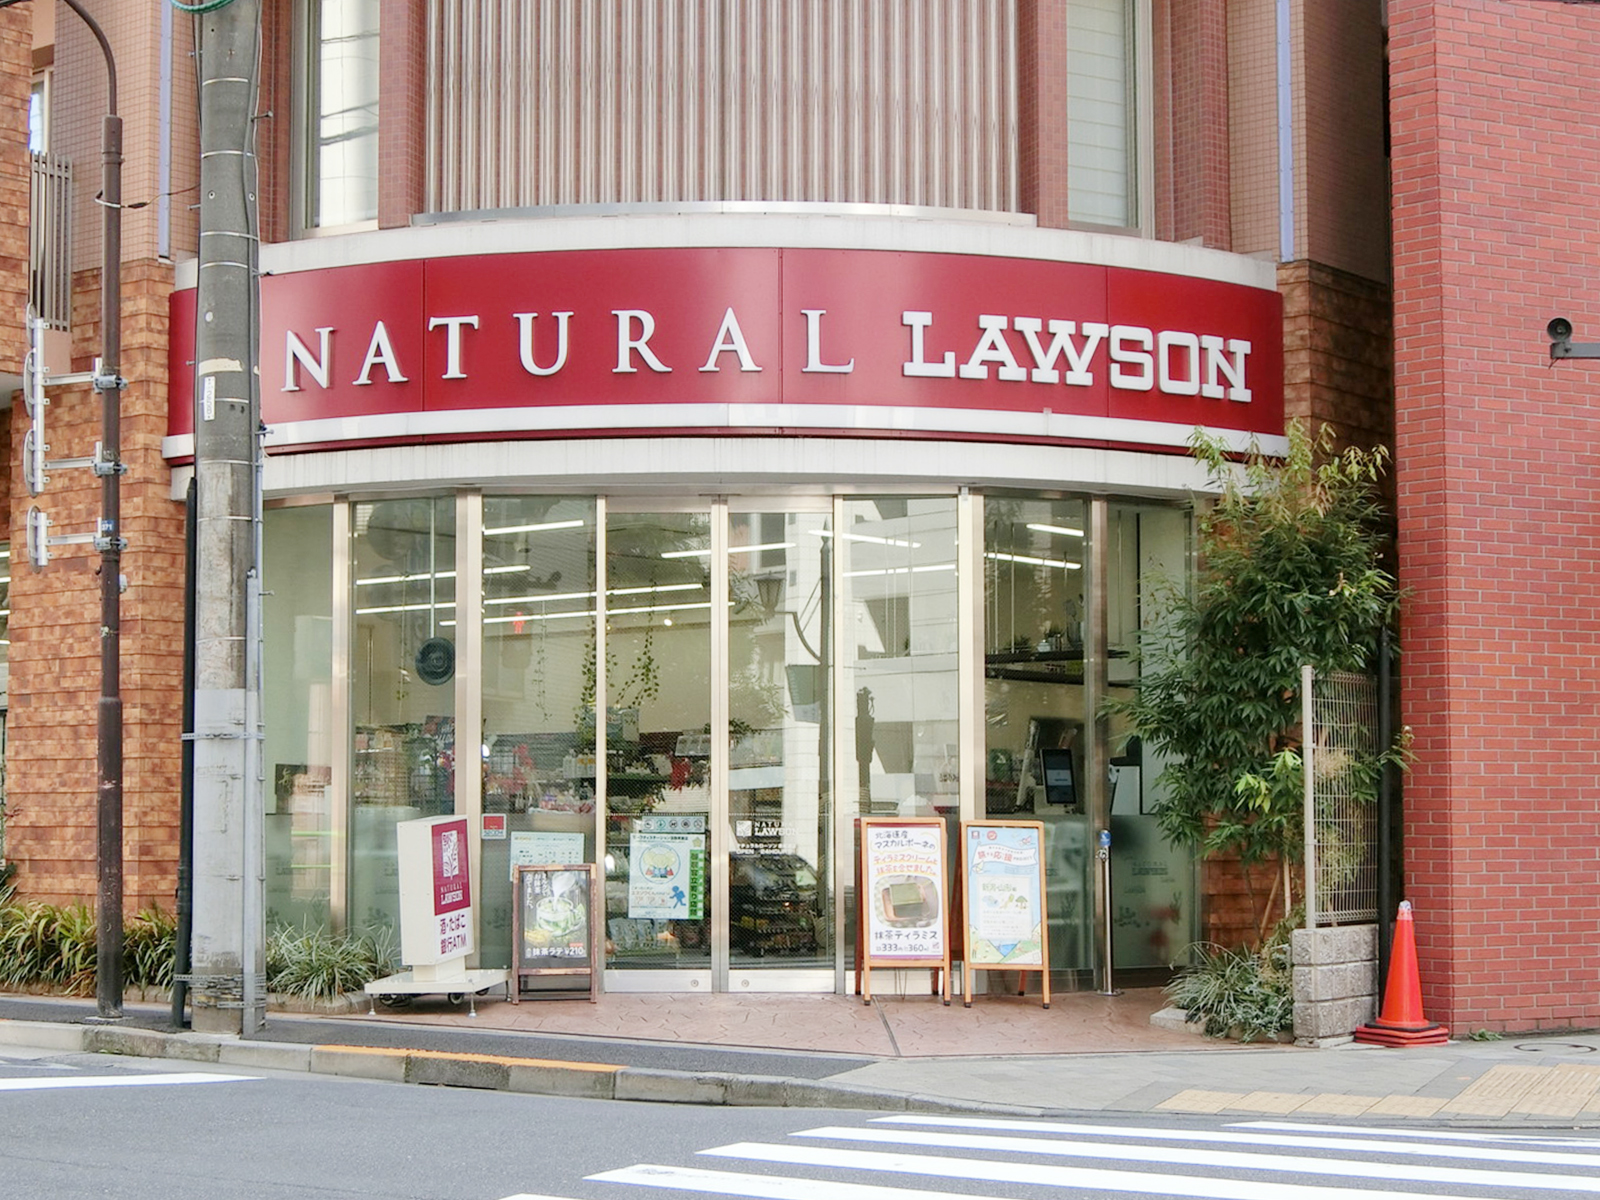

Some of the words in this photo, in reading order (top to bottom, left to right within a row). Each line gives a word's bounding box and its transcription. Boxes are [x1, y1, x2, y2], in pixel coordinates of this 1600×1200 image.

[281, 306, 856, 393] NATURAL
[902, 310, 1253, 404] LAWSON
[875, 830, 908, 839] 北海道産
[875, 930, 938, 940] 抹茶ティラミス
